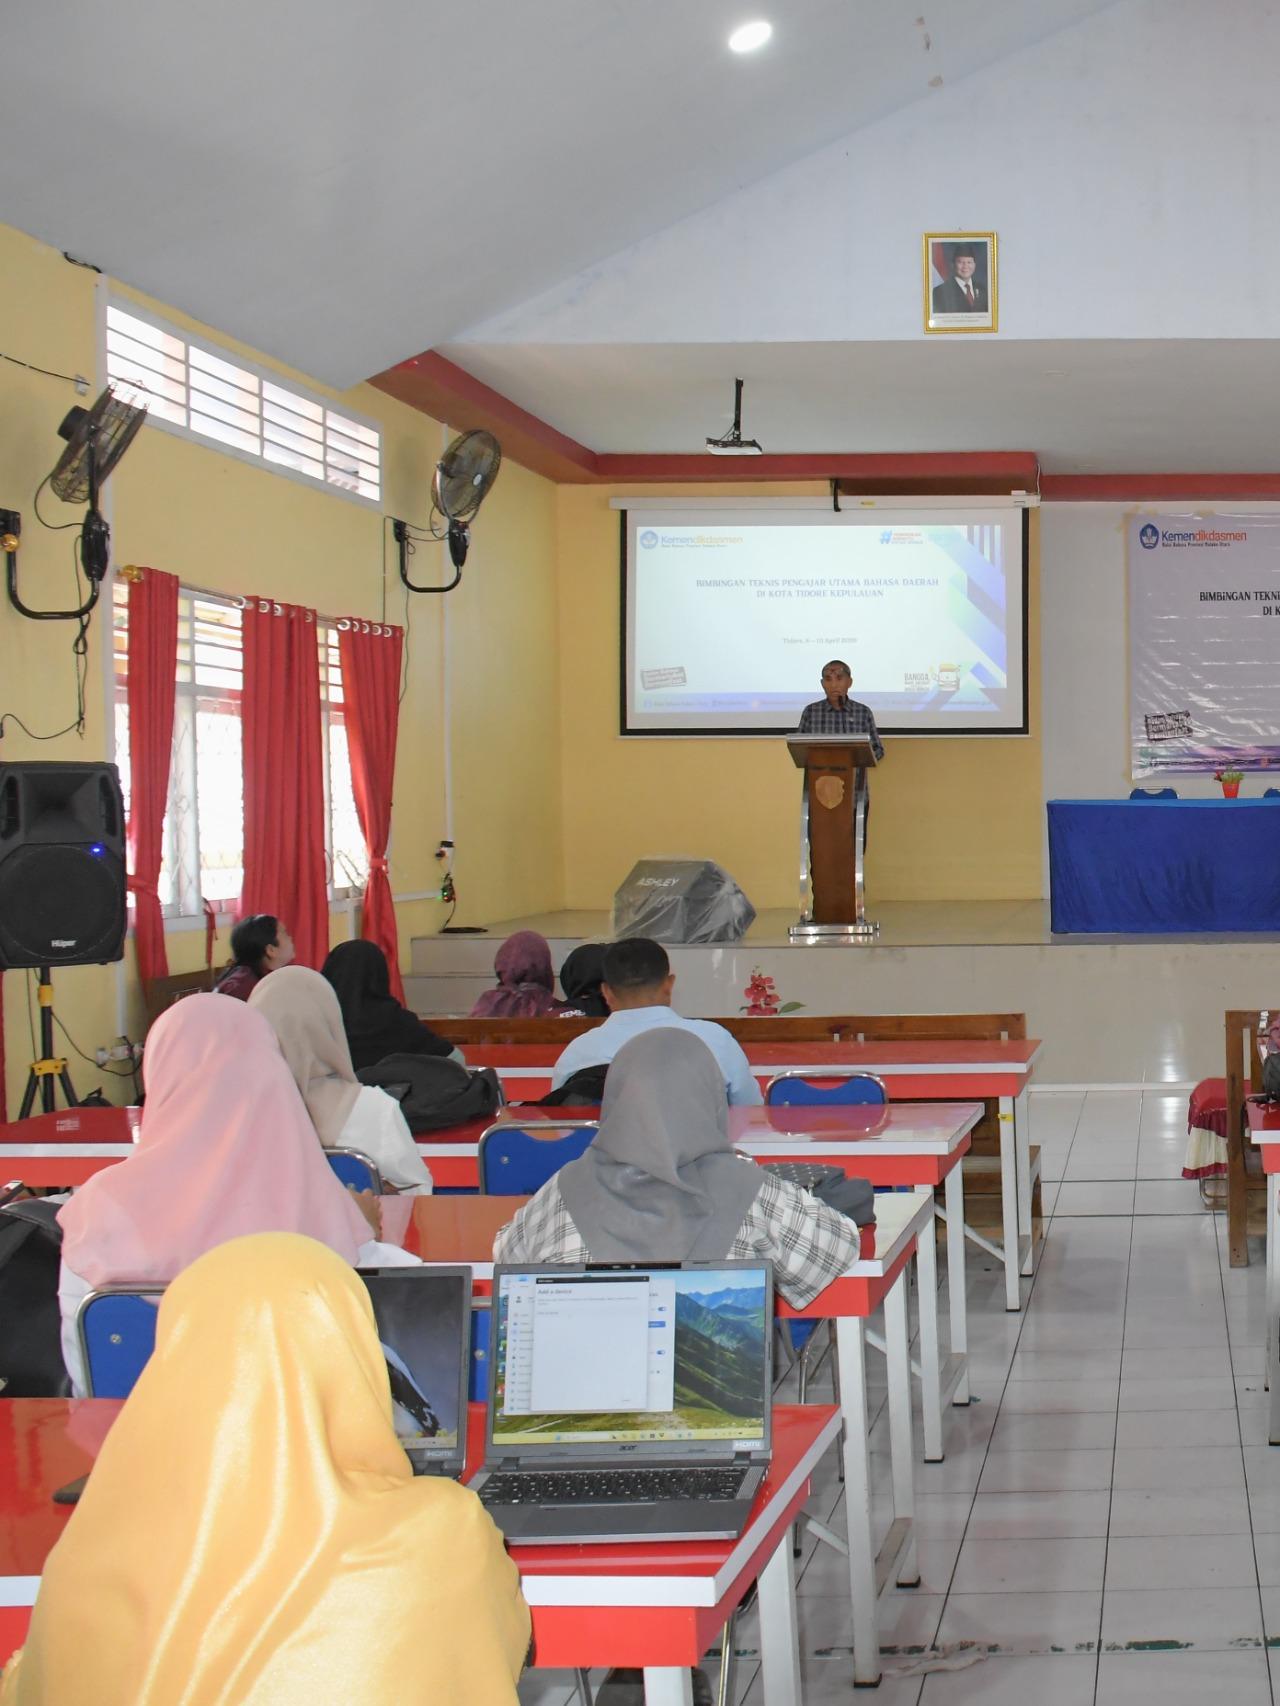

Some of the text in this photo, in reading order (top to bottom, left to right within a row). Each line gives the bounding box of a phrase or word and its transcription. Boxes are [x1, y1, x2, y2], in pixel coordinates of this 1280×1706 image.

[1161, 530, 1247, 542] Kemendikdasmen
[696, 577, 939, 588] BIMBINGAN TEKNIS PENGAJAR UTAMA BAHASA DAERAH
[756, 589, 884, 598] DI KOTA TIDORE KEPULAUAN
[1262, 606, 1272, 616] DI
[635, 877, 680, 888] ASHLEY
